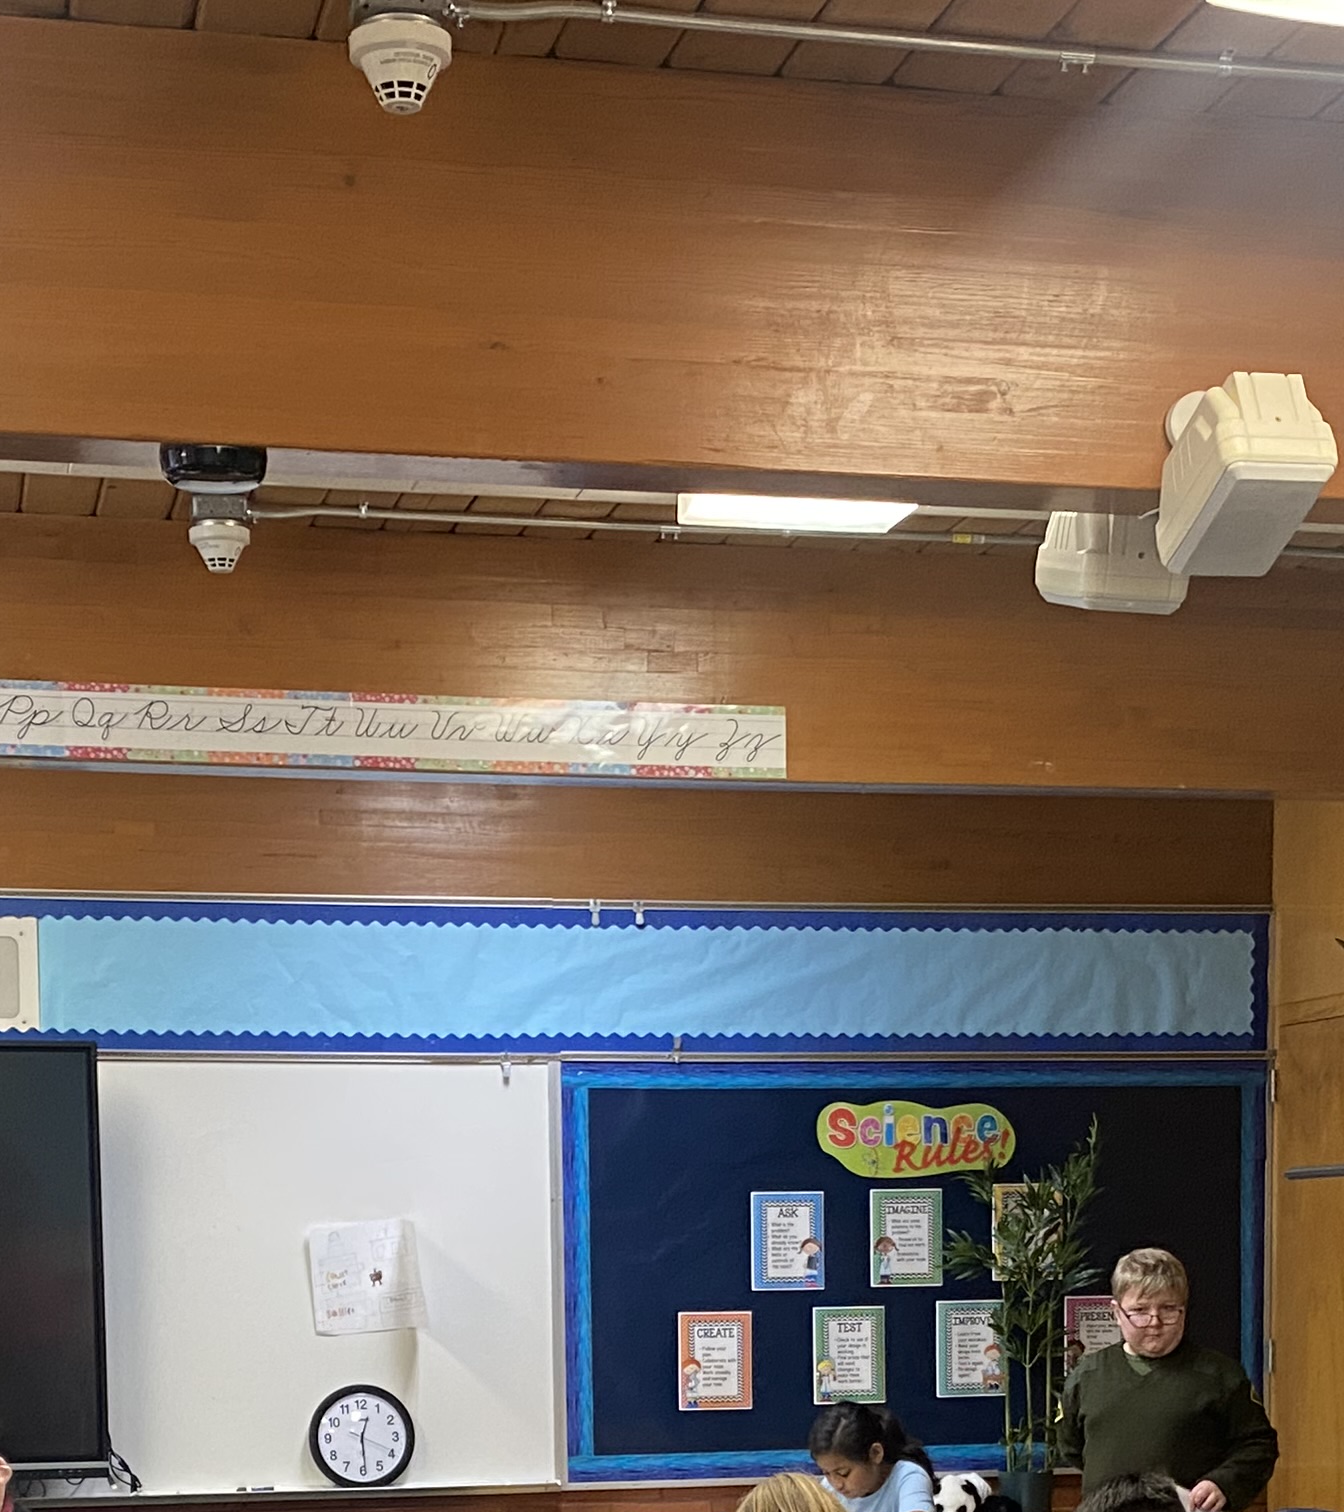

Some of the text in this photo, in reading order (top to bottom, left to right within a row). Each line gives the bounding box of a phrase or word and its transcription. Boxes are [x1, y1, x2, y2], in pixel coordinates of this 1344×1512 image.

[827, 1103, 1001, 1149] Science
[892, 1129, 1010, 1174] Rules!
[777, 1208, 799, 1219] ASK
[886, 1205, 929, 1215] IMAGINE
[1080, 1311, 1116, 1321] PRESEN
[696, 1328, 735, 1339] CREATE
[837, 1322, 863, 1334] TEST
[340, 1404, 349, 1414] 11
[355, 1399, 367, 1410] 12
[375, 1403, 380, 1414] 1
[328, 1417, 340, 1428] 10
[387, 1415, 394, 1425] 2
[324, 1433, 332, 1444] 9
[392, 1432, 399, 1442] 3
[330, 1450, 337, 1461] 8
[388, 1448, 395, 1459] 4
[343, 1461, 350, 1472] 7
[360, 1465, 367, 1476] 6
[376, 1461, 383, 1471] 5
